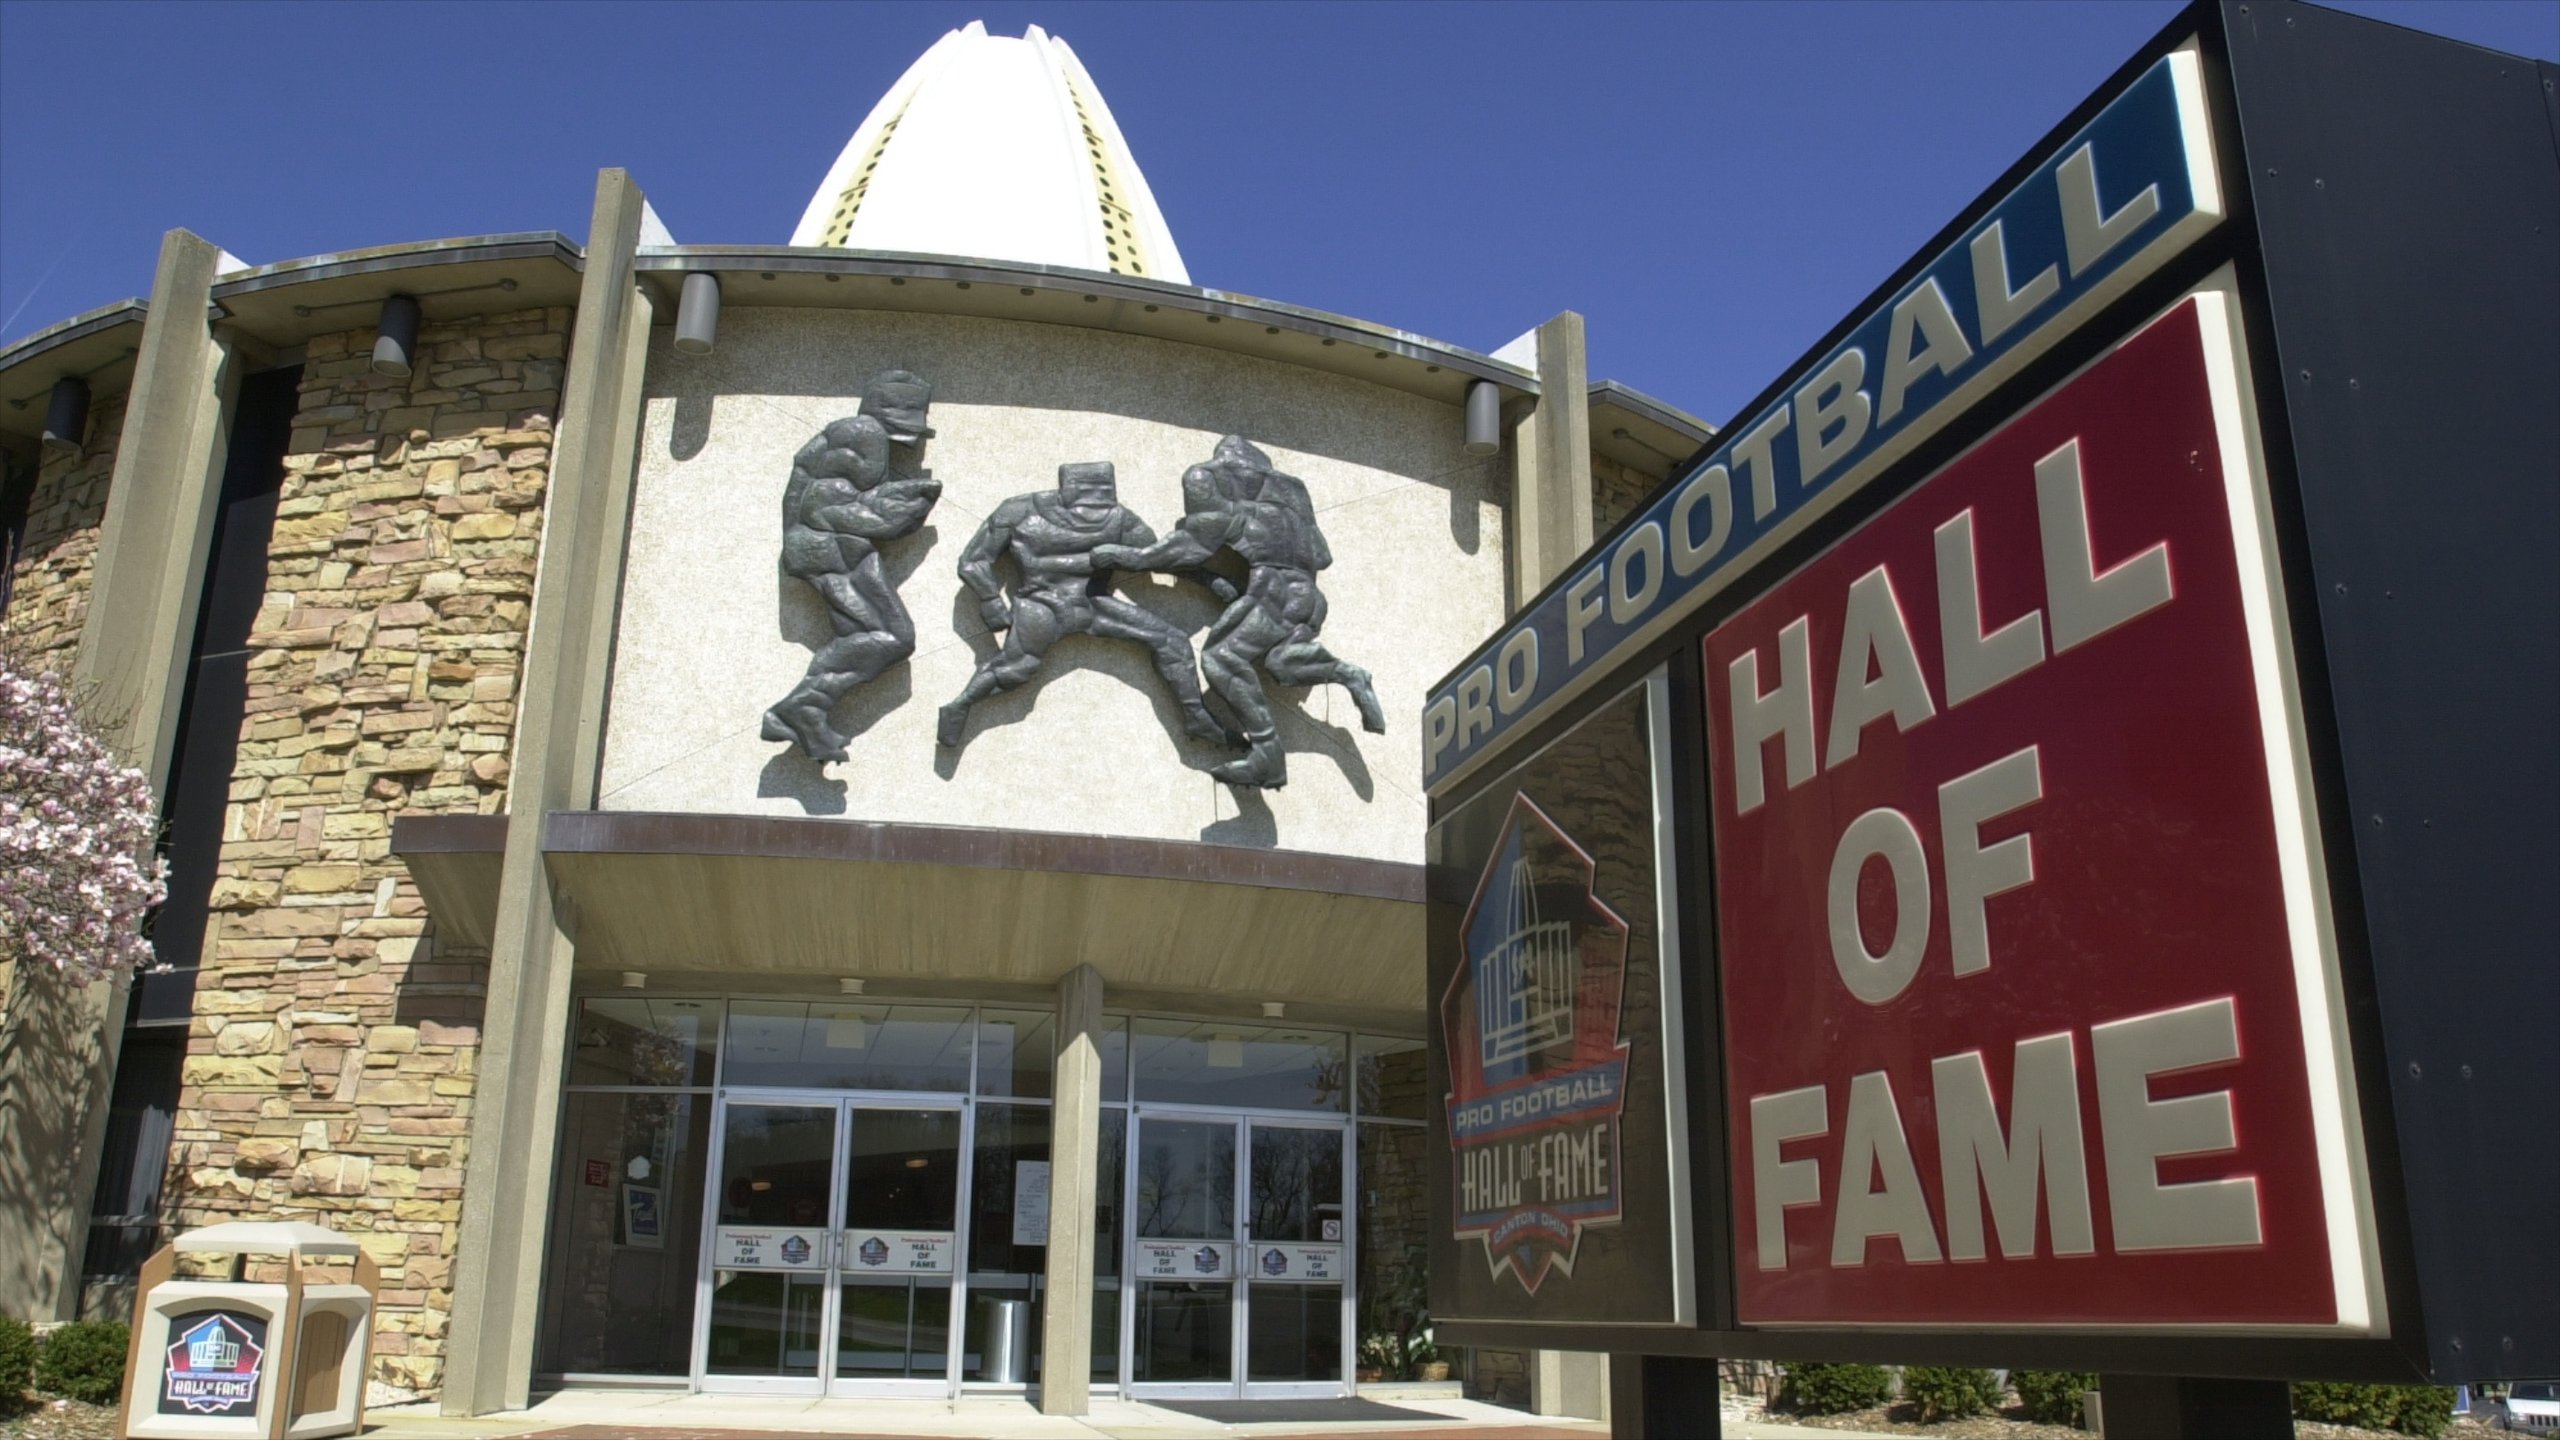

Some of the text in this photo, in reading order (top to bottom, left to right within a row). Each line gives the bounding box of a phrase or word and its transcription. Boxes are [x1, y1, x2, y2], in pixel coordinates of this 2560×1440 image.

[1424, 141, 2160, 773] PRO FOOTBALL
[1728, 437, 2173, 816] HALL
[1828, 744, 2043, 1005] OF
[1456, 1073, 1613, 1131] PRO FOOTBALL
[1750, 996, 2263, 1270] FAME
[1461, 1123, 1609, 1213] HALL OF FAME
[1493, 1210, 1569, 1243] CANTON OHIO
[736, 1240, 761, 1248] HALL
[741, 1248, 754, 1256] OF
[911, 1244, 937, 1252] HALL
[917, 1252, 930, 1260] OF
[734, 1256, 760, 1264] FAME
[910, 1261, 936, 1269] FAME
[174, 1380, 207, 1395] HALL
[214, 1381, 249, 1396] FAME
